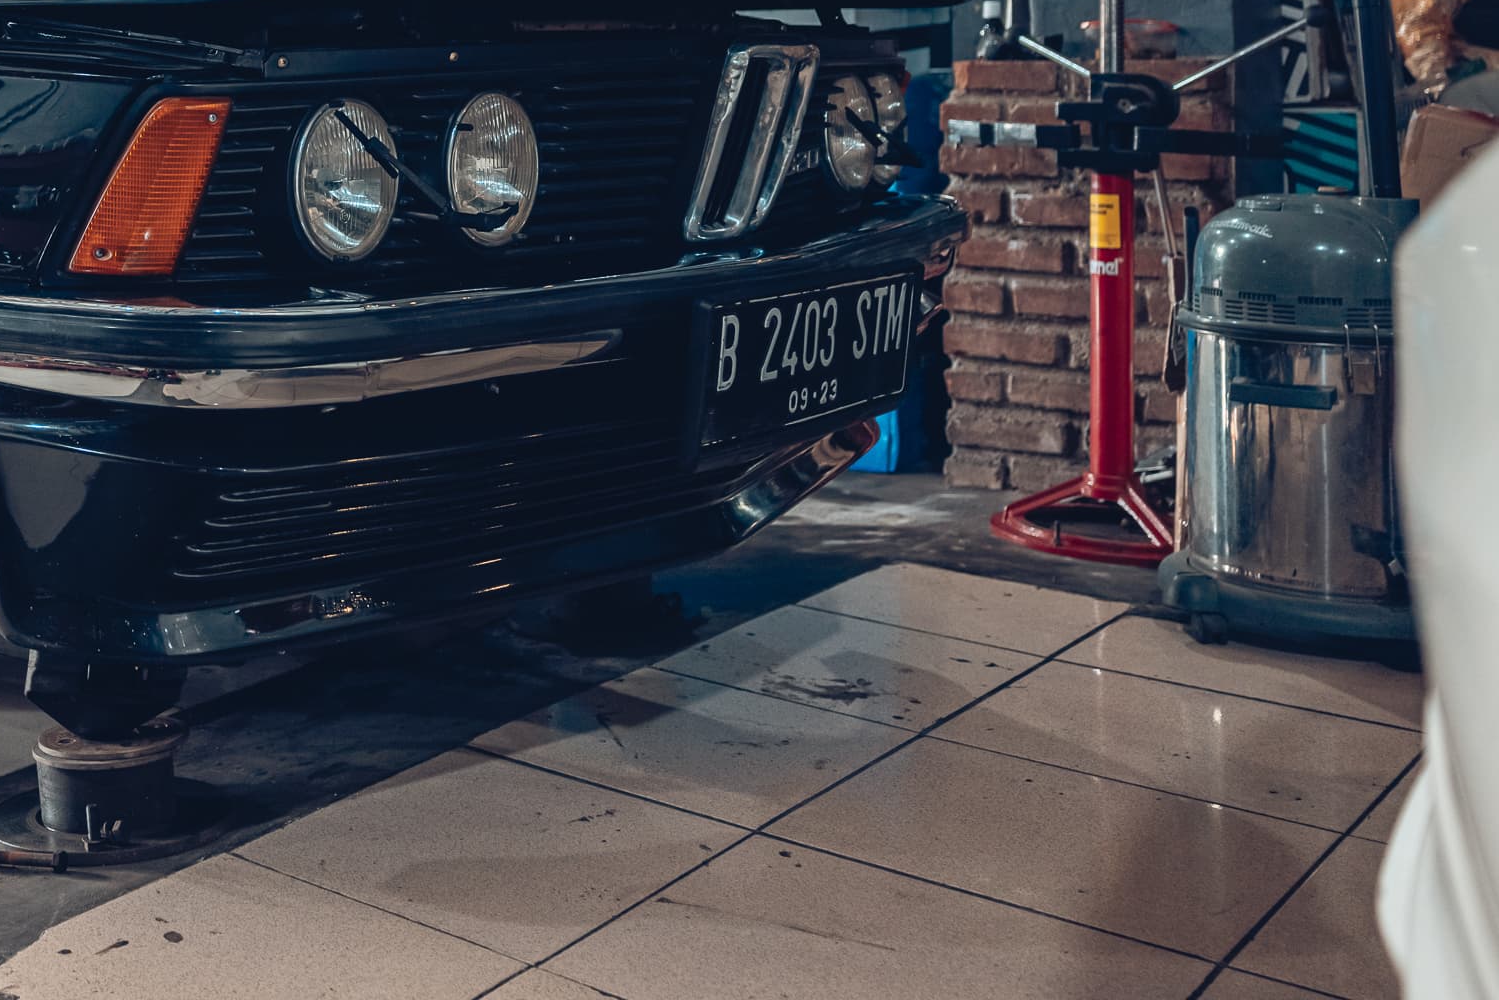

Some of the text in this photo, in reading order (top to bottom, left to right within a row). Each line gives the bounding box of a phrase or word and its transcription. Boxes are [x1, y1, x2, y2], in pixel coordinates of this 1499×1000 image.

[716, 282, 908, 392] B 2403 STM
